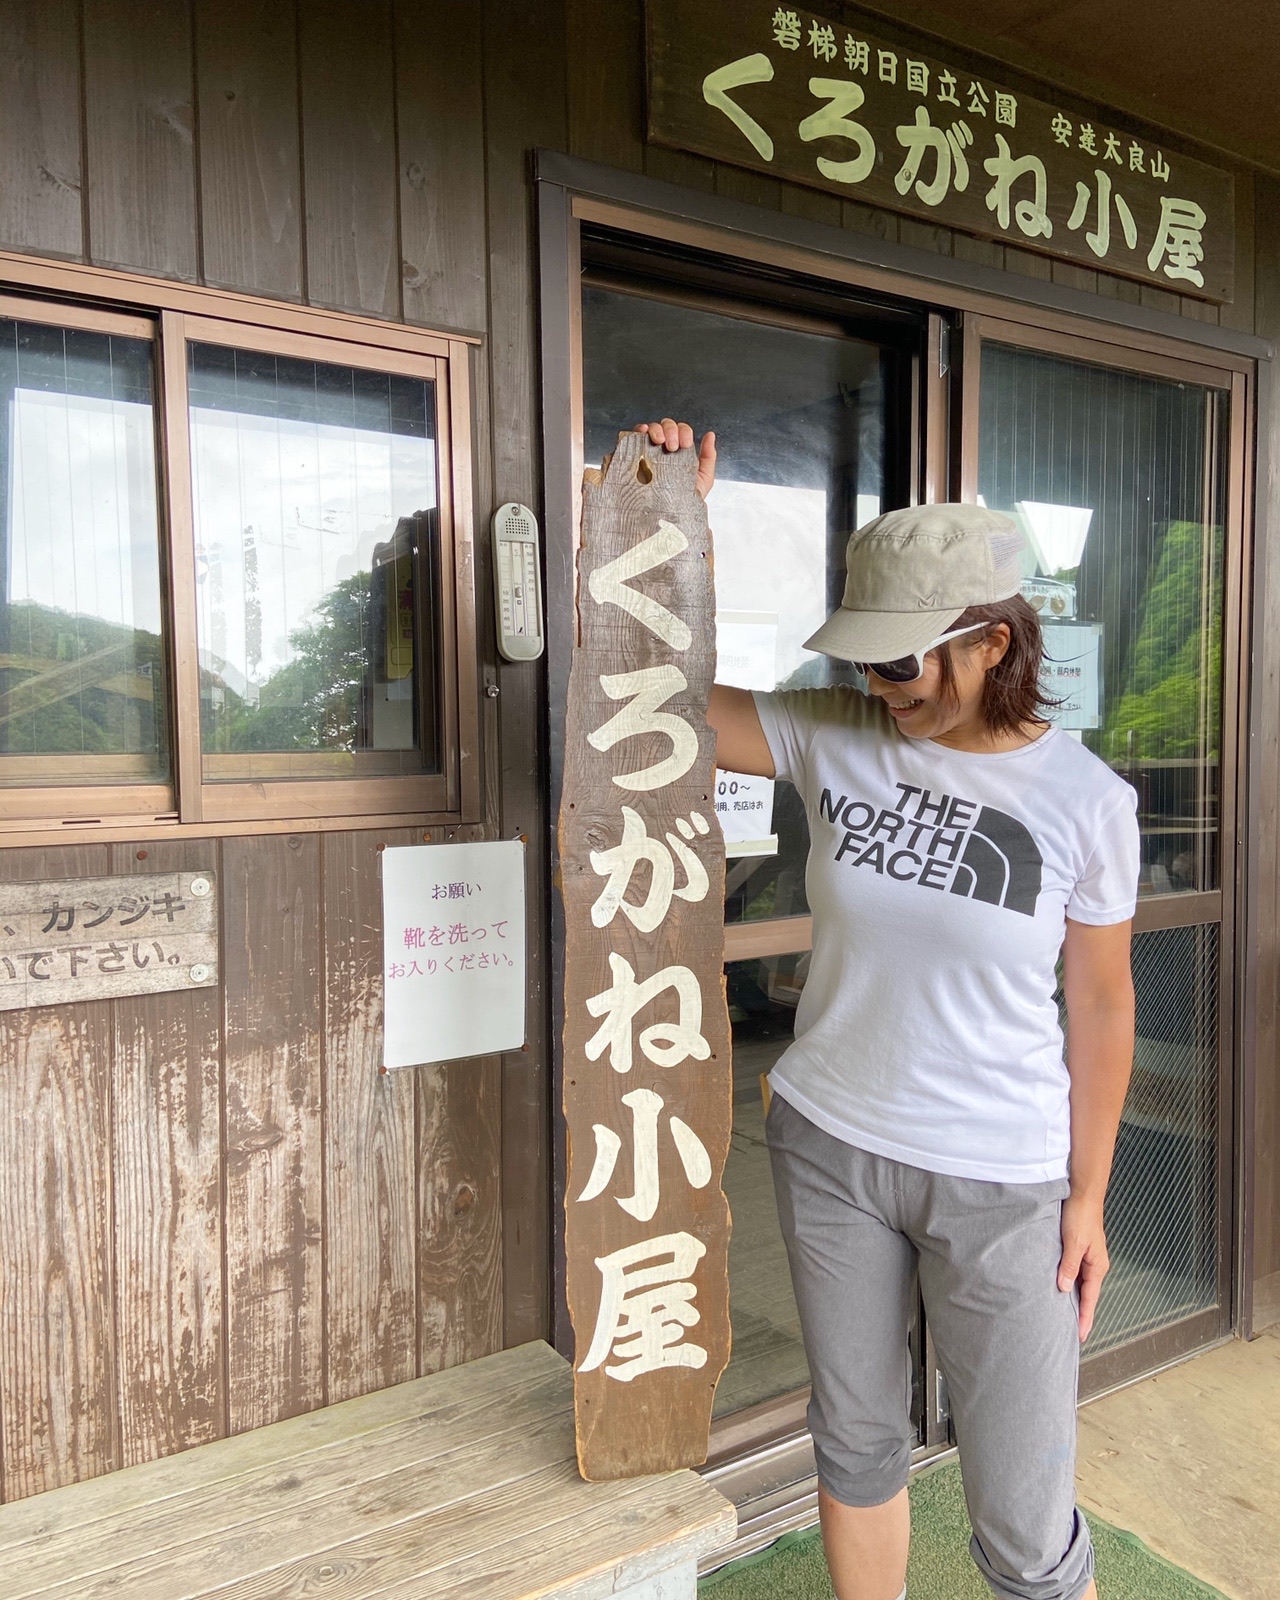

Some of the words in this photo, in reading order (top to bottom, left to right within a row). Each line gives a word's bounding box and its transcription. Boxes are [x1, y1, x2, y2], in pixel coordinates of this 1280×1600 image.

[771, 7, 1017, 128] 磐梯朝日国立公園
[1051, 113, 1170, 182] 安達太良山
[702, 53, 1207, 288] くろがね小屋
[819, 788, 965, 862] NORTH
[895, 782, 977, 830] THE
[431, 881, 482, 900] お願い
[834, 831, 953, 891] FACE
[403, 920, 509, 950] 靴を洗って
[577, 519, 712, 1383] くろがね小屋
[388, 951, 514, 980] お入りください。
